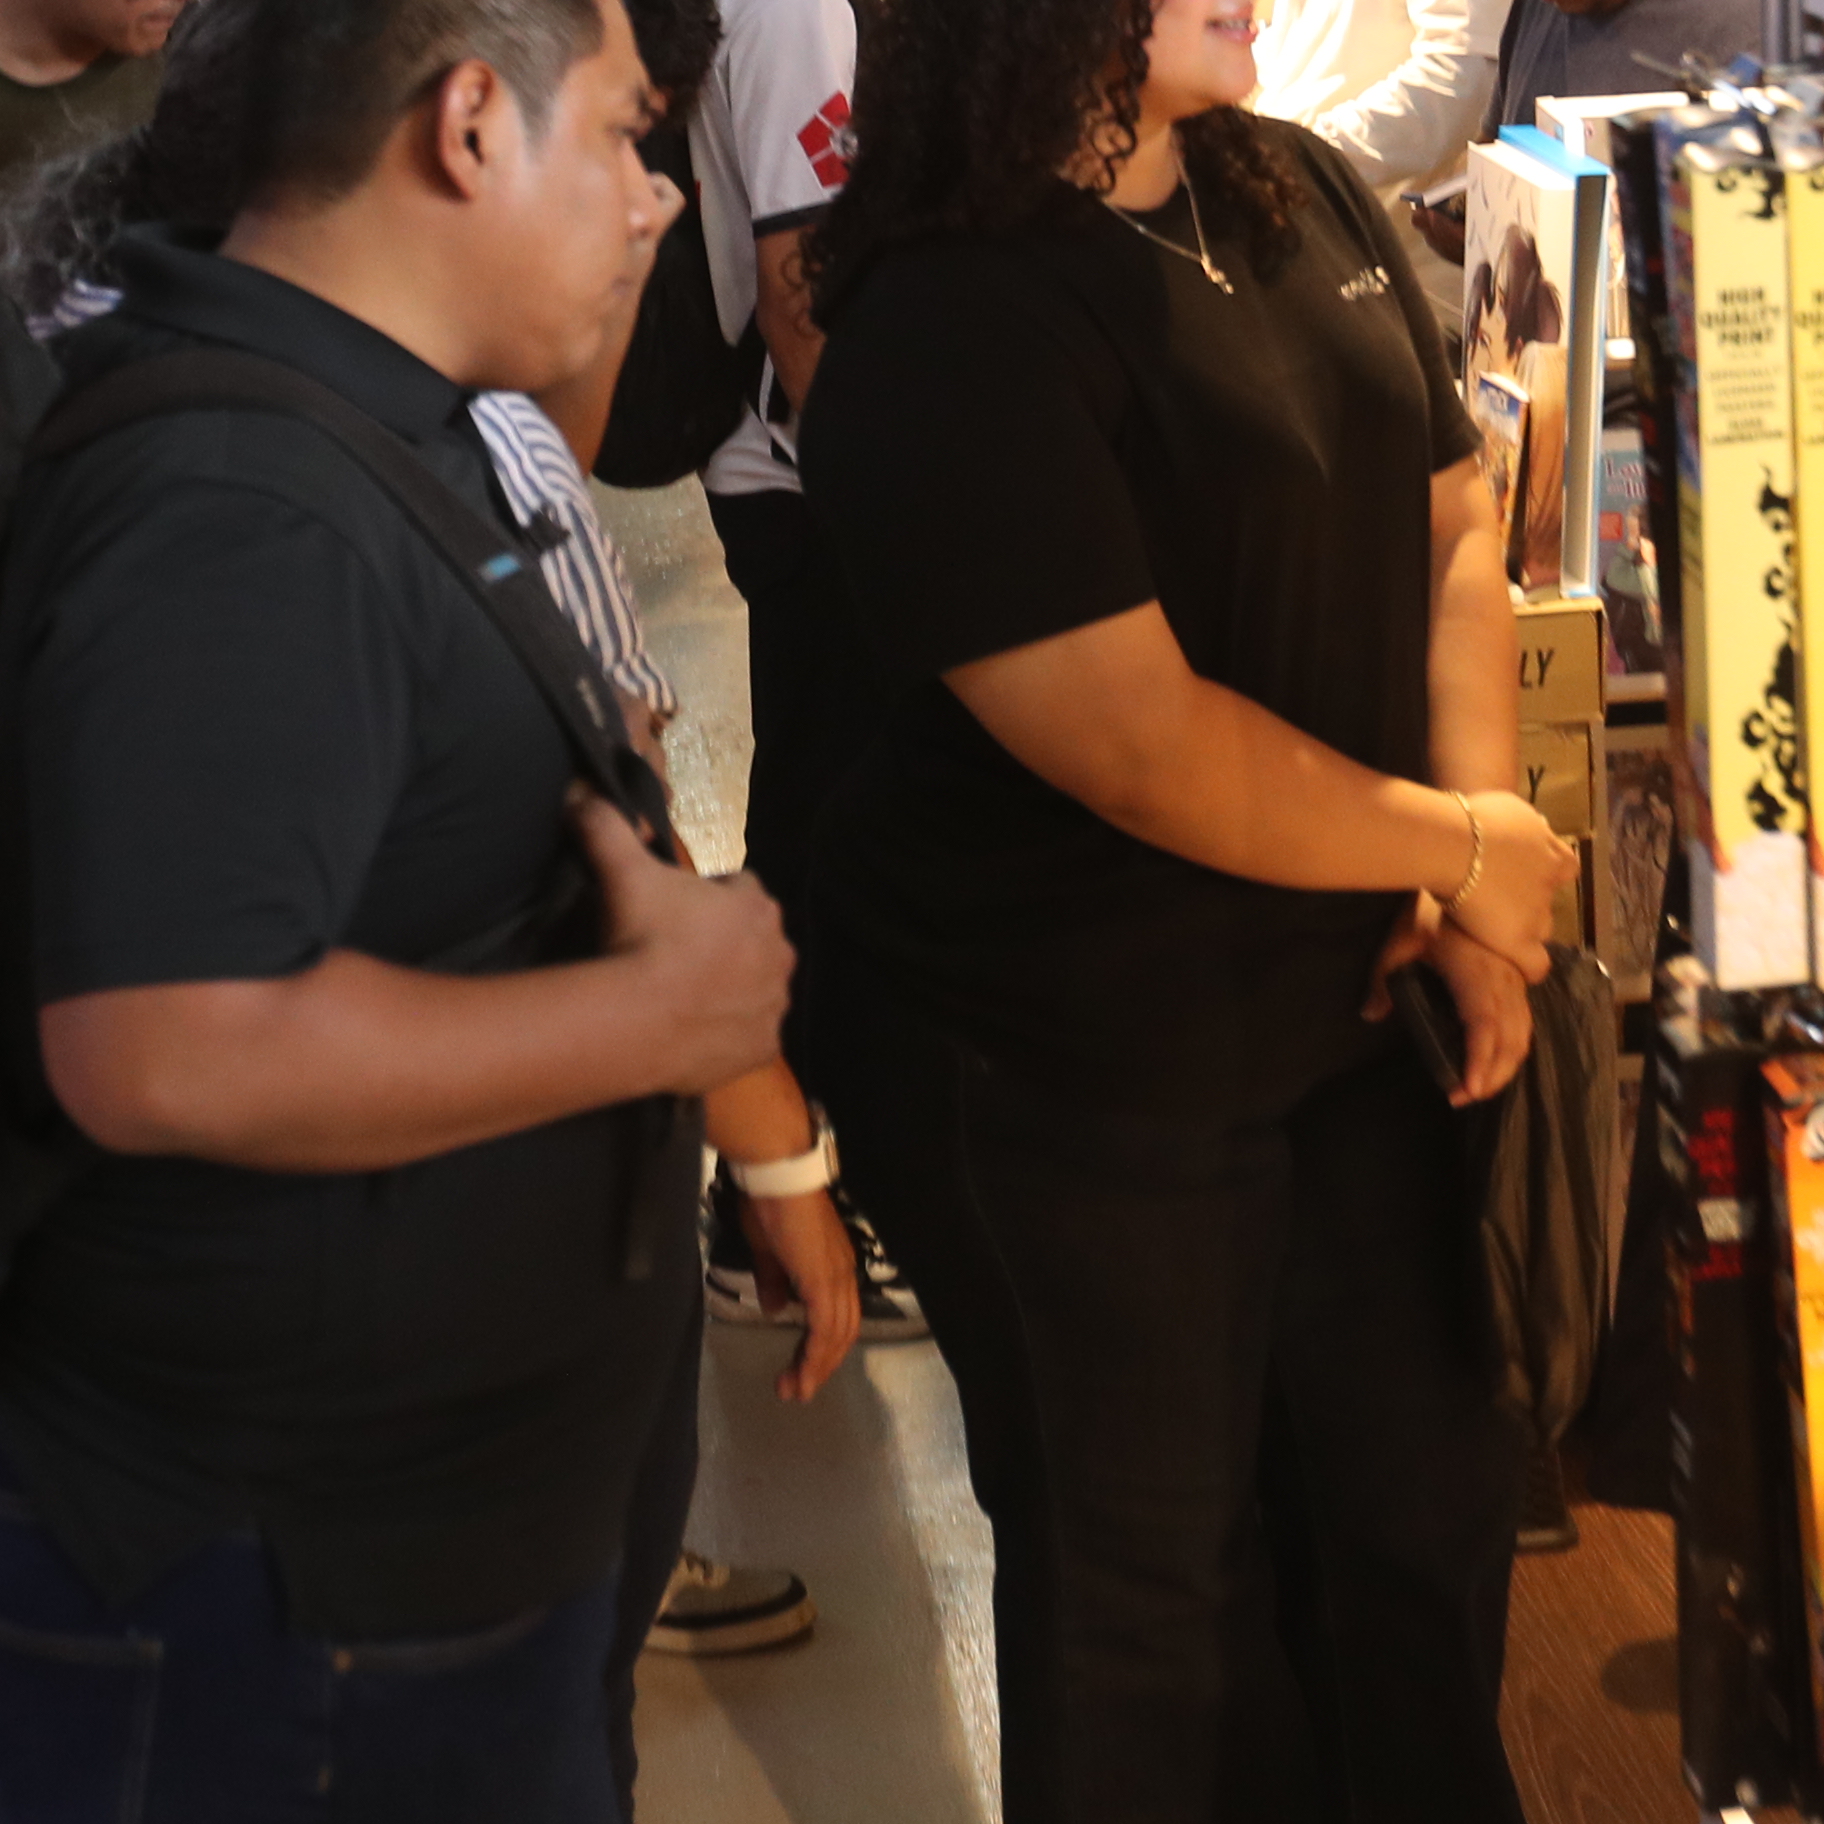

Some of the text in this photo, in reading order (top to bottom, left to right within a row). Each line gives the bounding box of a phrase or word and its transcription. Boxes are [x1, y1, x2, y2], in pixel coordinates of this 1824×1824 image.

[1718, 286, 1765, 303] HIGH
[1698, 304, 1781, 329] QUALITY
[1718, 327, 1774, 348] PRINT
